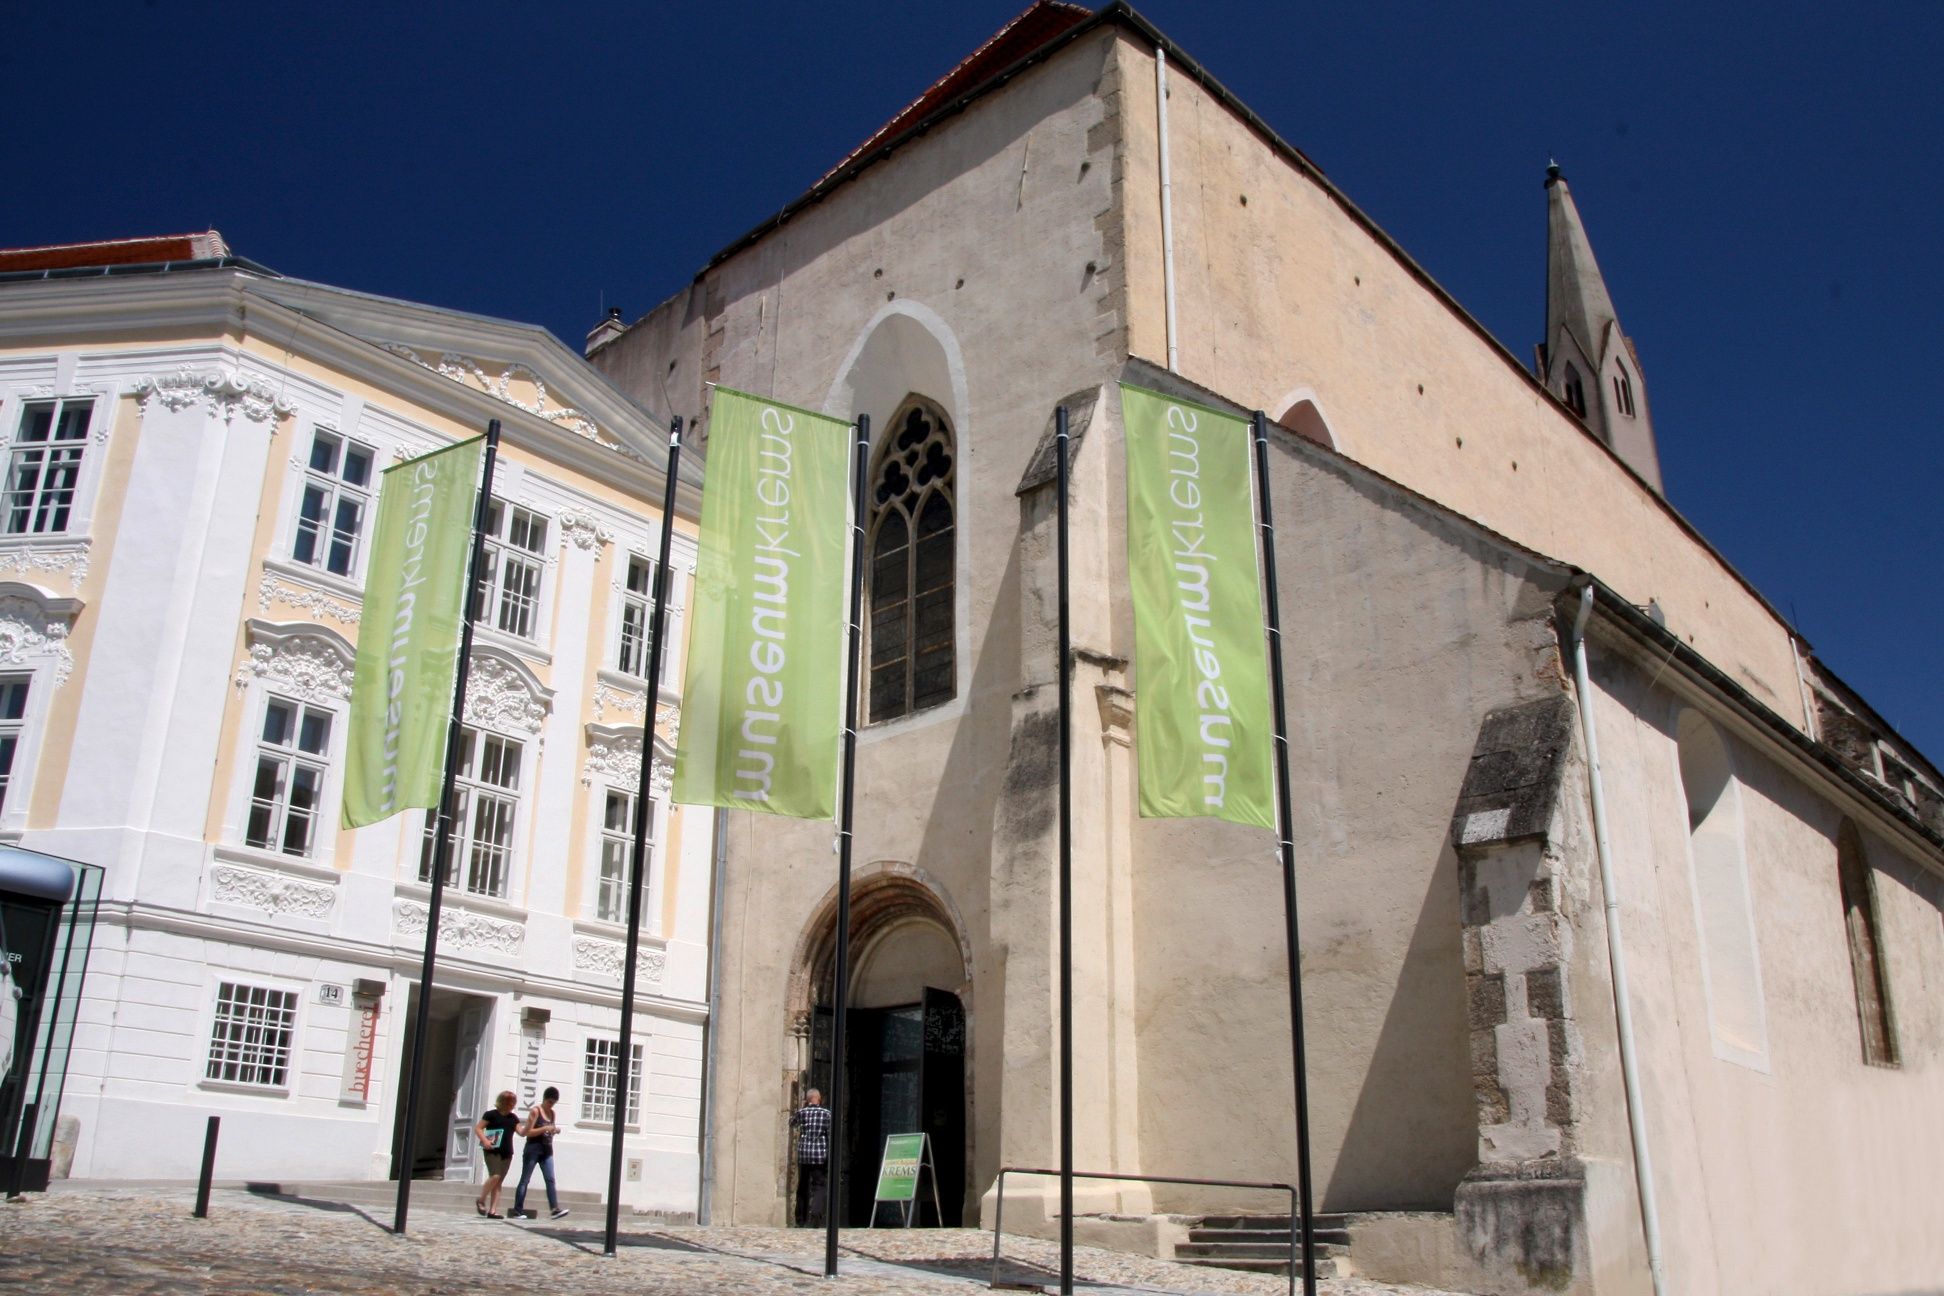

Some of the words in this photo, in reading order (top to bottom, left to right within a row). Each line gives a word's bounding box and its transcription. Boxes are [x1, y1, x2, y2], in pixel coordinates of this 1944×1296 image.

[6, 951, 23, 963] ER
[325, 986, 339, 999] 14
[348, 1004, 375, 1094] buecherei
[518, 1041, 540, 1112] kultur
[882, 1166, 917, 1177] KREMS
